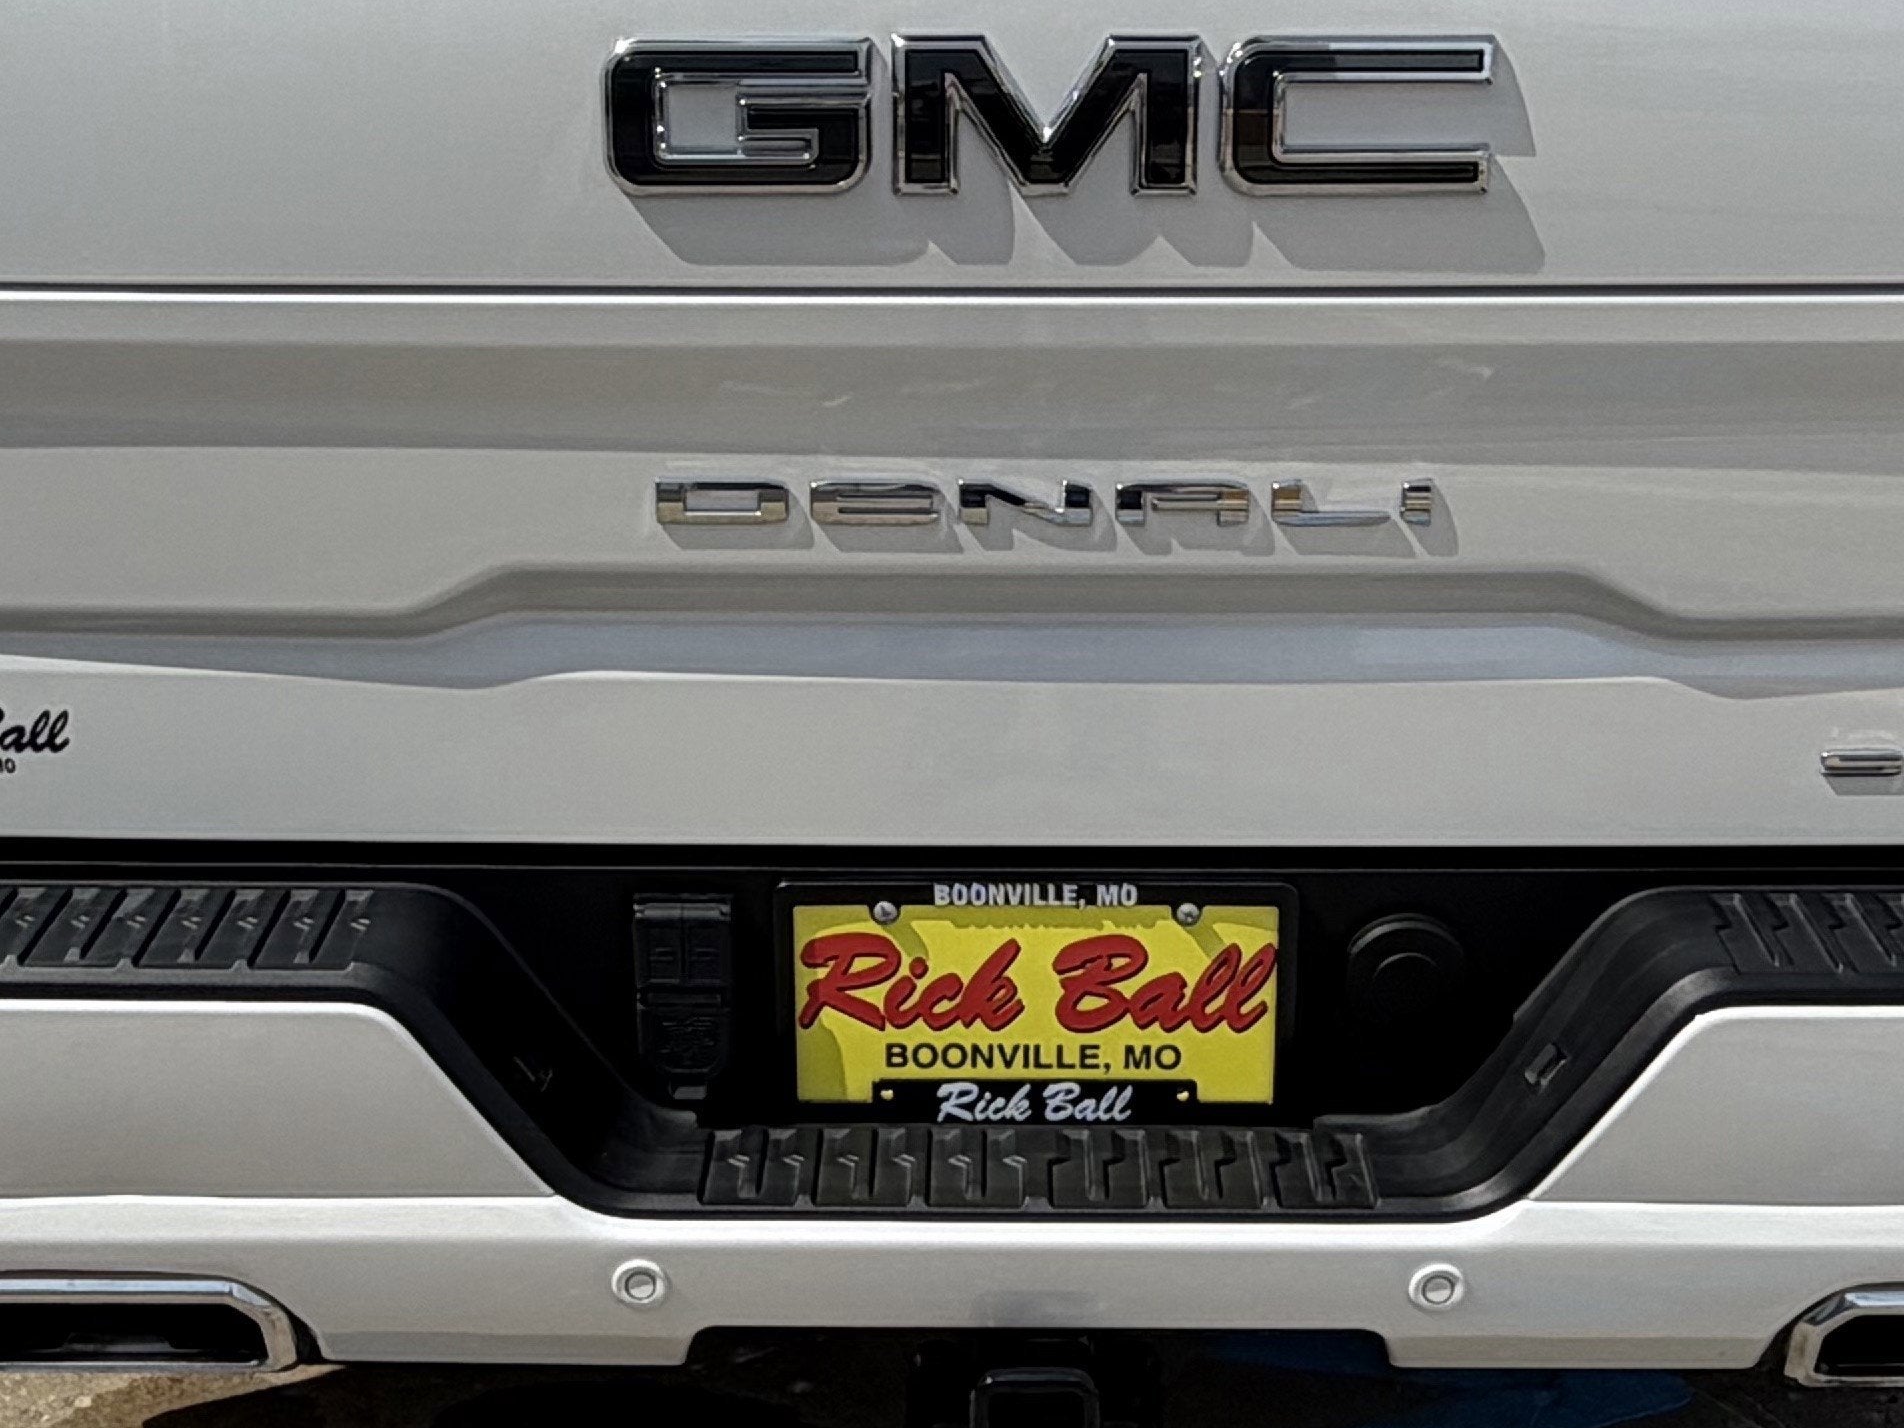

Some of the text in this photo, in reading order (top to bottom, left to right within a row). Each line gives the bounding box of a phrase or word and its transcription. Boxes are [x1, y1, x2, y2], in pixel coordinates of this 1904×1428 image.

[603, 34, 1495, 196] GMC
[654, 478, 1432, 525] DENALI
[933, 882, 1138, 909] BOONVILLE, MO
[798, 931, 1278, 1034] Rick Ball
[885, 1042, 1182, 1072] BOONVILLE, MO
[936, 1081, 1134, 1123] Rick Ball
